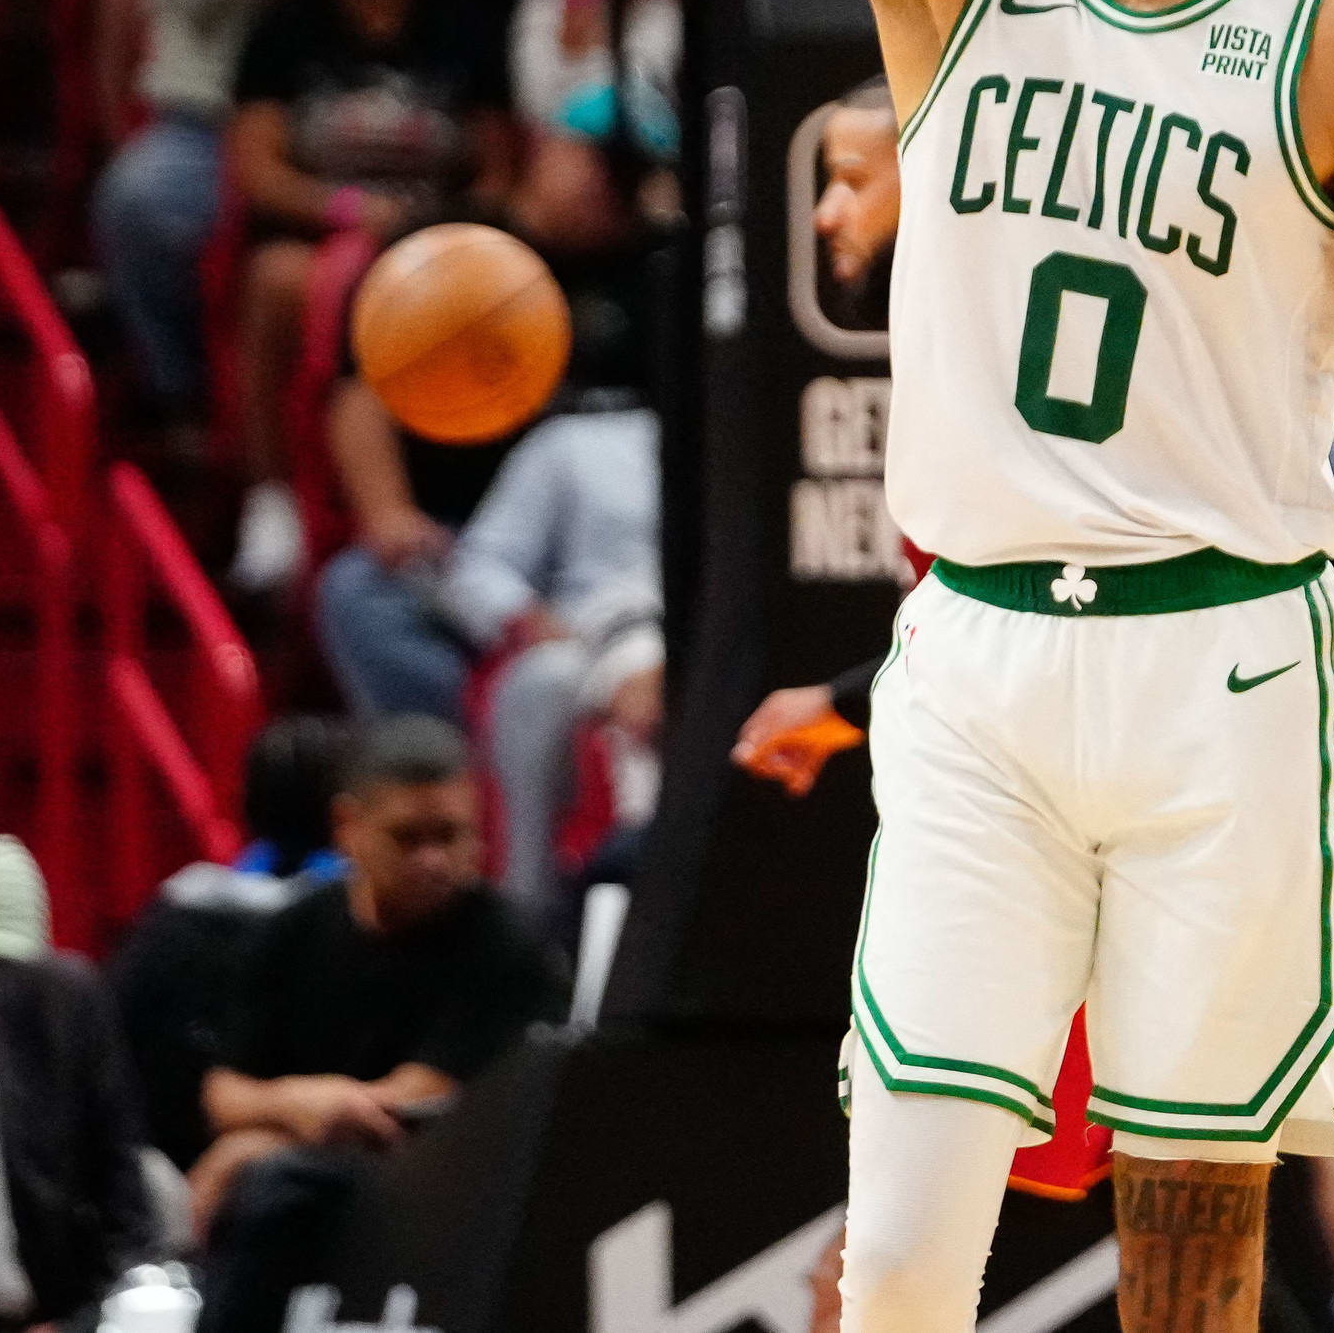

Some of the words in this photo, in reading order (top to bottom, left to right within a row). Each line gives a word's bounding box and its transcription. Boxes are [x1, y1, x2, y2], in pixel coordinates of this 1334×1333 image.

[1201, 53, 1269, 81] PRINT
[1209, 24, 1272, 61] VISTA
[949, 73, 1252, 277] CELTICS
[1014, 250, 1148, 444] 0
[799, 376, 893, 475] GE
